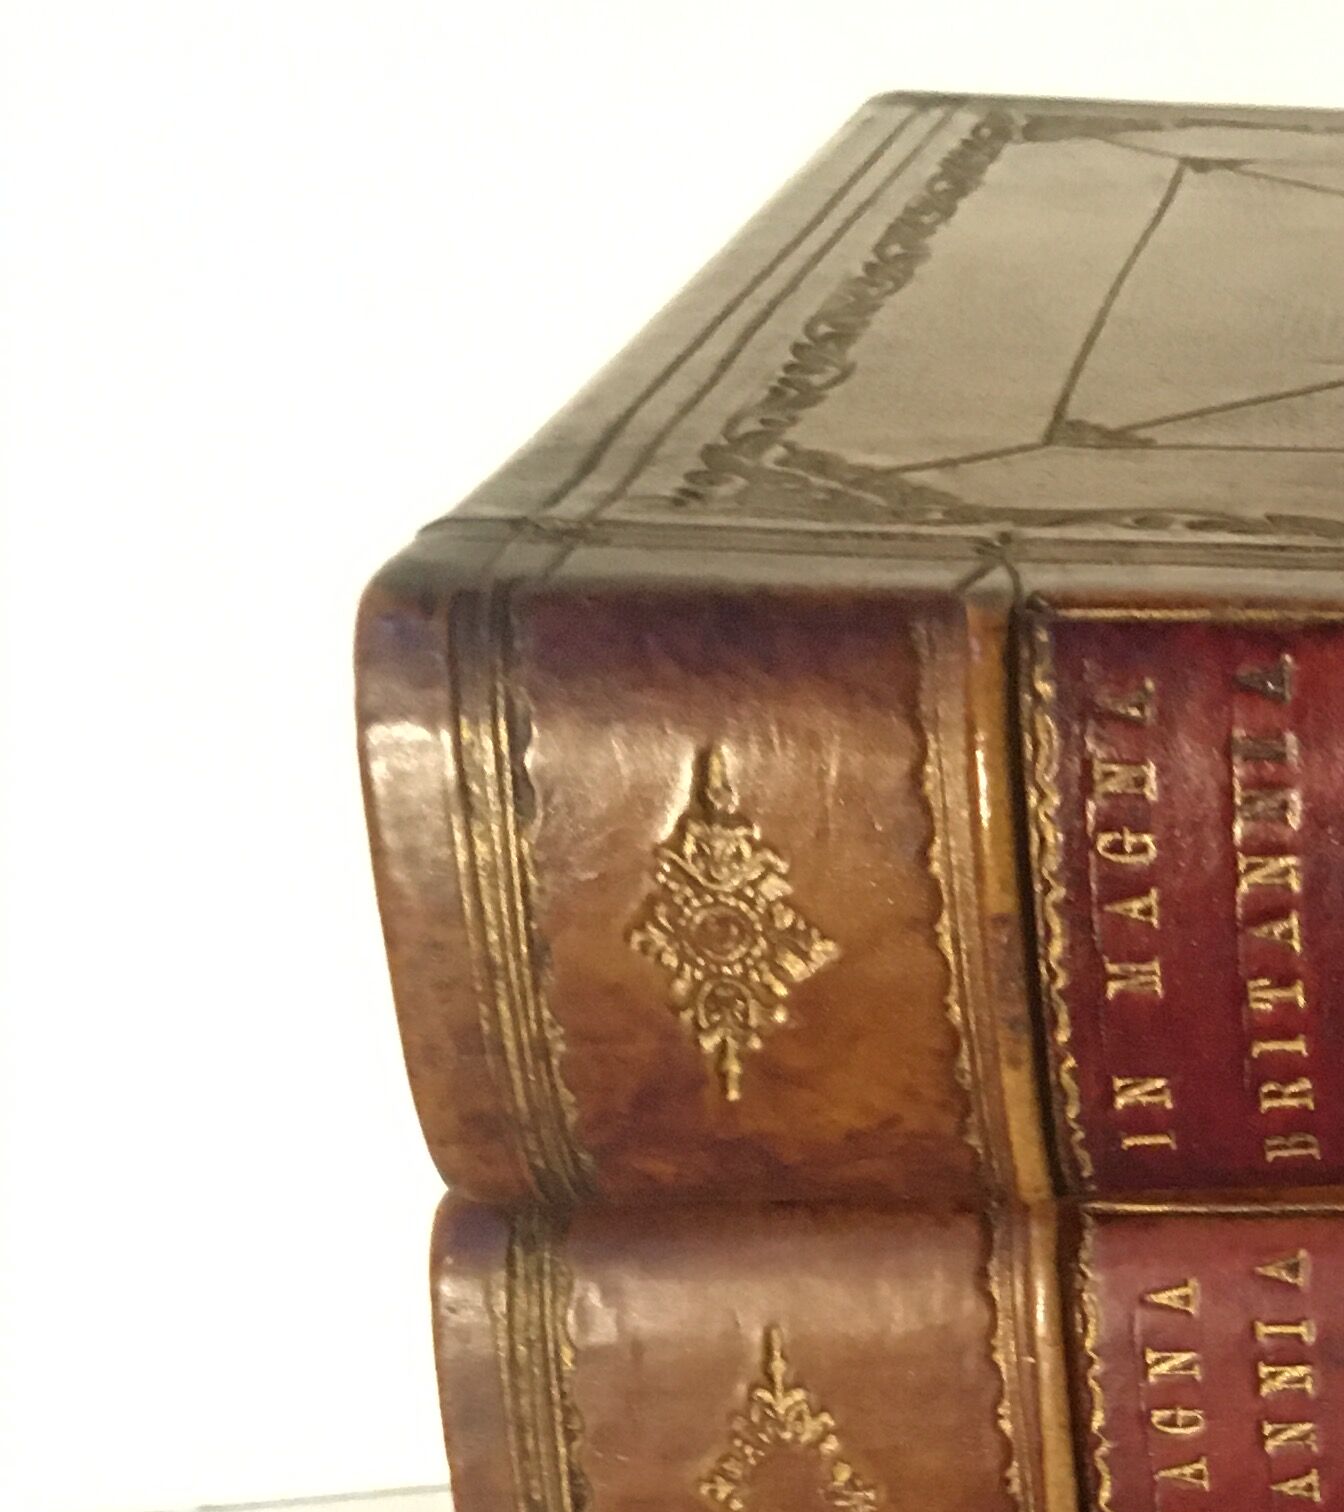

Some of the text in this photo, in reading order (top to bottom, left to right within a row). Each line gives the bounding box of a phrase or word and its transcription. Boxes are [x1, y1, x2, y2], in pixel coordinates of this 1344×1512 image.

[1093, 677, 1177, 1150] IN MAGNA
[1232, 653, 1321, 1161] BRITANNIA
